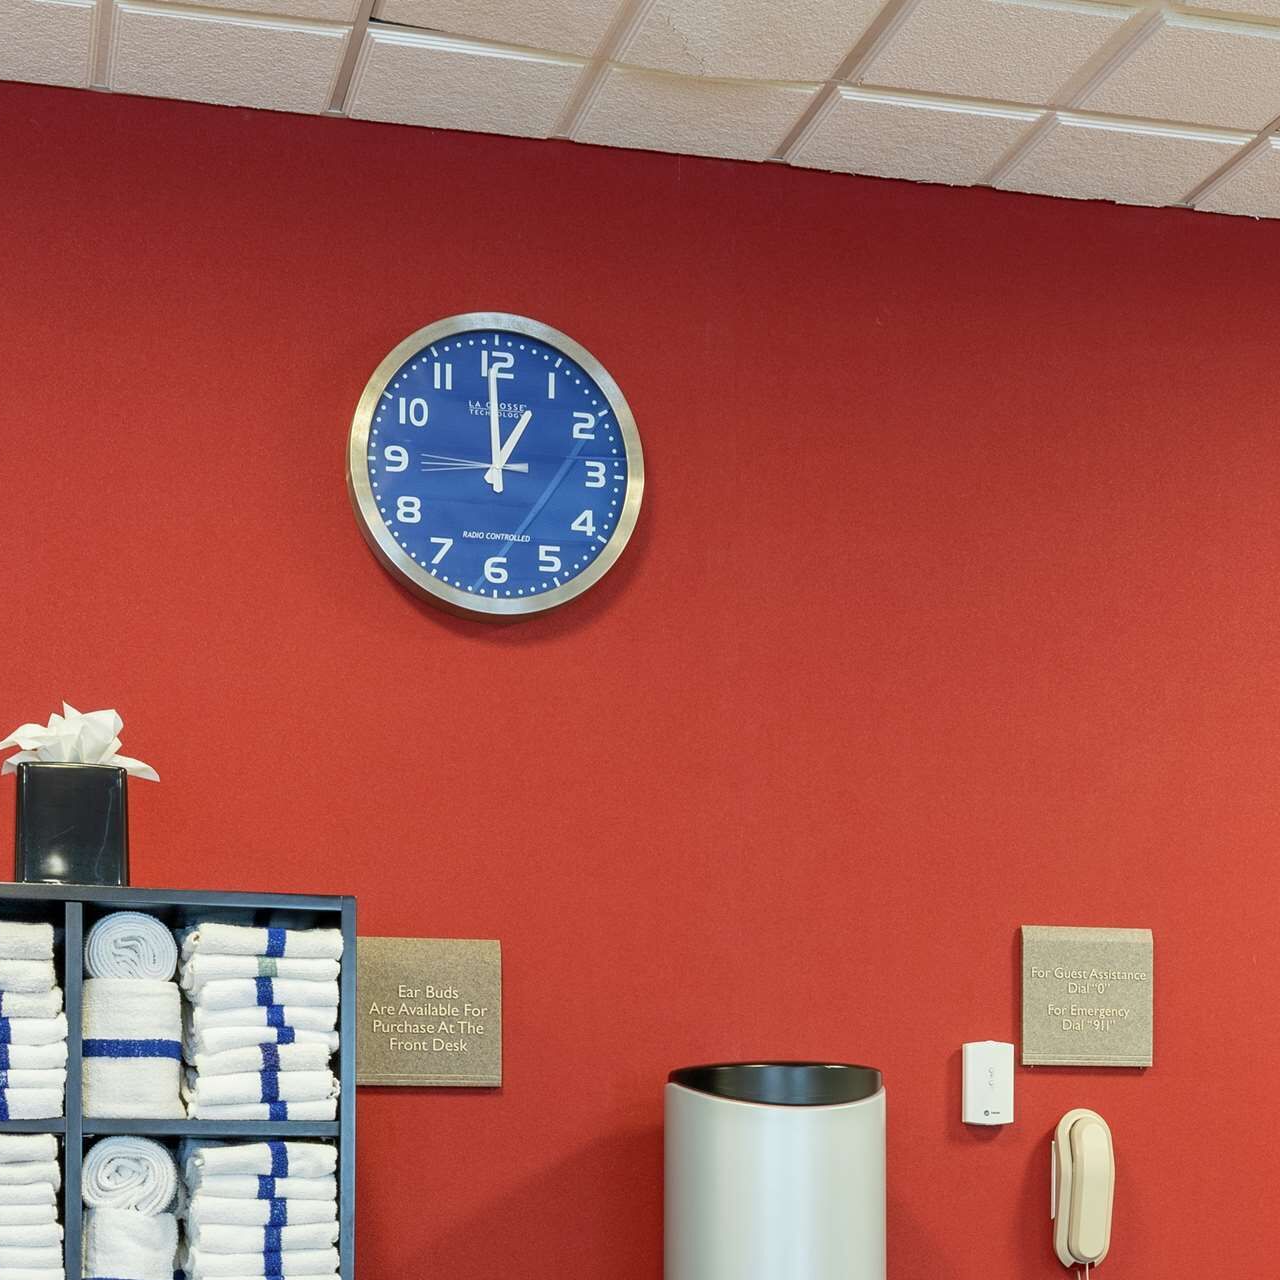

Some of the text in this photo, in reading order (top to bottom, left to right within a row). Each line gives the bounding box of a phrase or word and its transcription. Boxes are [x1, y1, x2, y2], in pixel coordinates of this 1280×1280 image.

[433, 362, 452, 390] 11
[481, 350, 515, 379] 12
[548, 372, 555, 399] 1
[398, 397, 429, 427] 10
[486, 402, 525, 412] COSSE
[572, 412, 595, 440] 2
[383, 445, 409, 472] 9
[584, 461, 606, 488] 3
[396, 496, 421, 524] 8
[570, 509, 596, 536] 4
[462, 530, 531, 543] RADIO CONTROLLED
[430, 537, 453, 564] 7
[538, 545, 562, 572] 5
[483, 557, 508, 584] 6
[1031, 967, 1147, 980] For Guest Assistance
[398, 985, 459, 999] Ear Buds
[1068, 983, 1090, 994] Dial
[369, 1002, 488, 1017] Are Available For
[1048, 1004, 1130, 1018] For Emergency
[373, 1020, 484, 1035] Purchase At The
[1062, 1019, 1084, 1031] Dial
[389, 1038, 468, 1052] Front Desk
